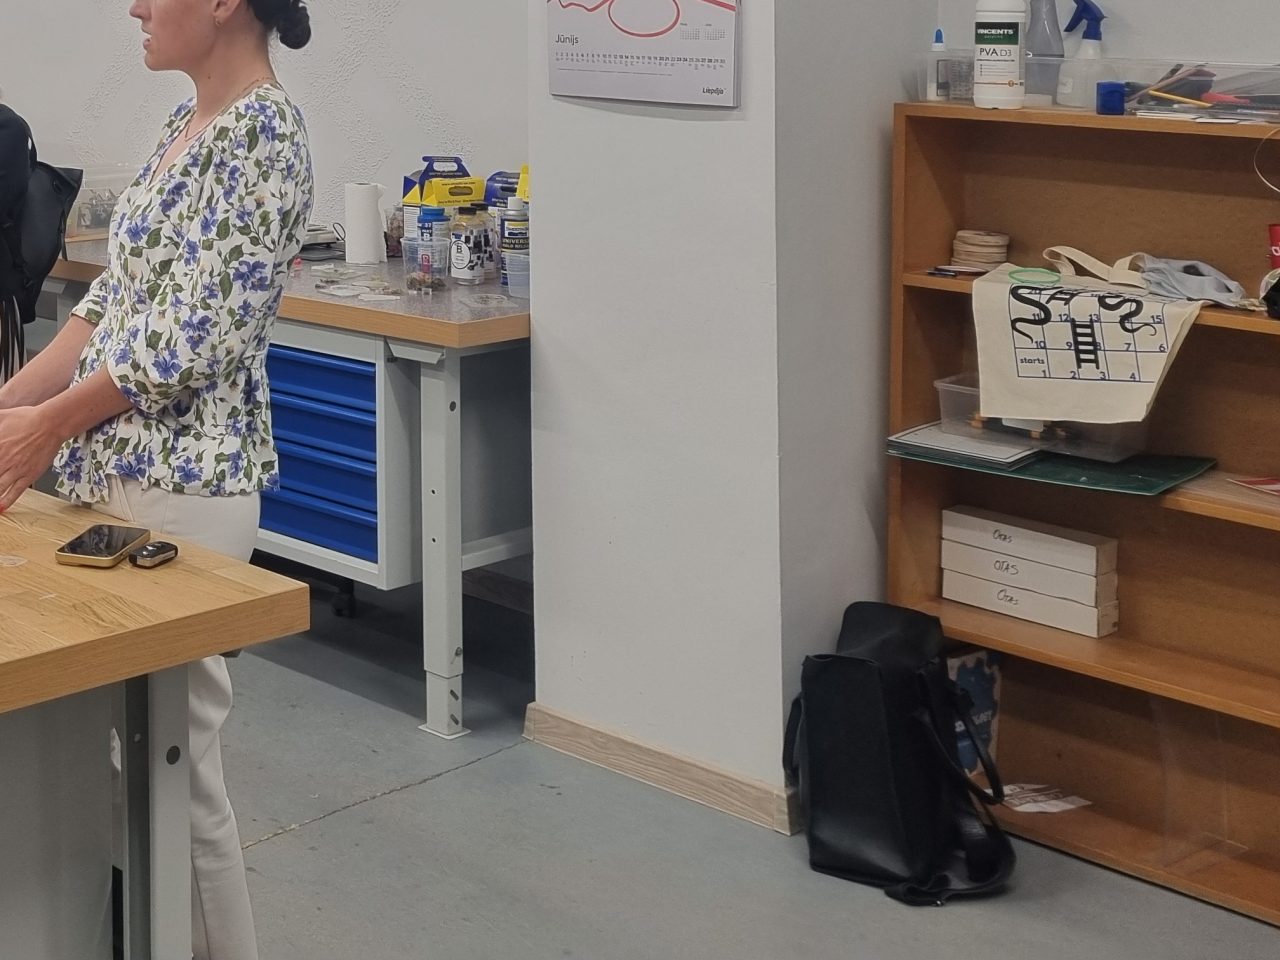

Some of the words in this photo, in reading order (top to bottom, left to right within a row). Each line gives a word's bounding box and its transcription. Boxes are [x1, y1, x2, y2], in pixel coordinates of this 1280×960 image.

[554, 34, 579, 46] Jūnijs
[979, 47, 999, 57] PVA
[1000, 49, 1012, 57] D3
[456, 245, 463, 253] B
[1058, 314, 1070, 323] 12
[1151, 315, 1163, 323] 15
[1035, 341, 1046, 349] 10
[1066, 342, 1073, 350] 9
[1124, 343, 1131, 351] 7
[1159, 343, 1166, 352] 6
[1020, 357, 1045, 365] starts
[1070, 371, 1077, 379] 2
[1100, 372, 1106, 380] 3
[1129, 372, 1136, 380] 4
